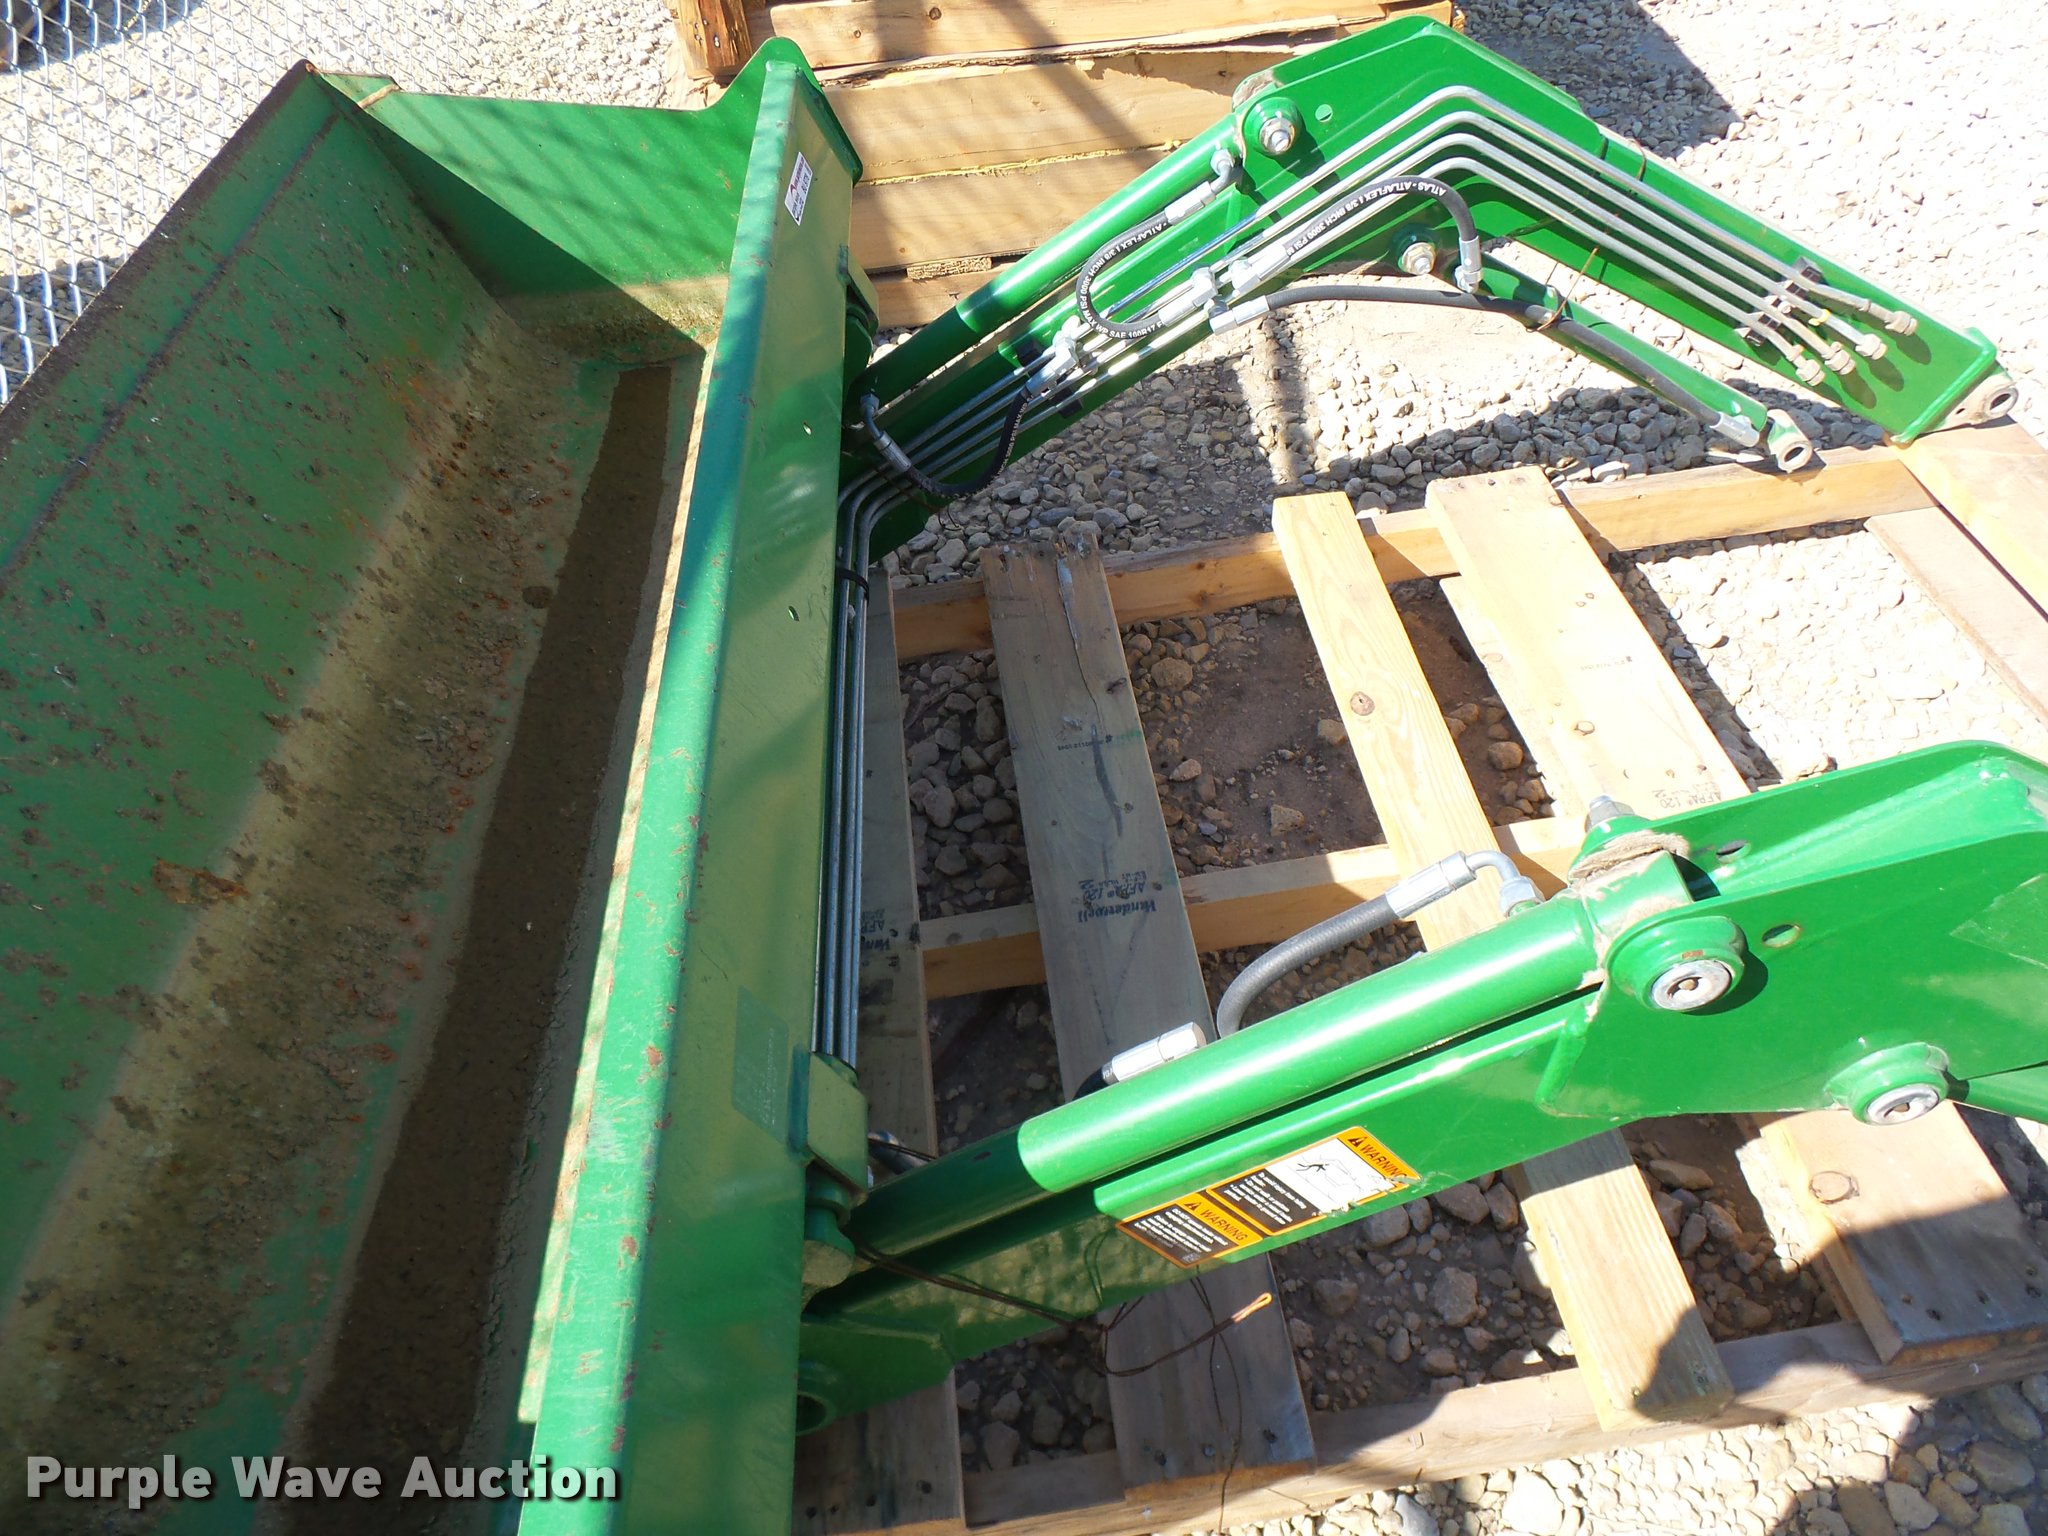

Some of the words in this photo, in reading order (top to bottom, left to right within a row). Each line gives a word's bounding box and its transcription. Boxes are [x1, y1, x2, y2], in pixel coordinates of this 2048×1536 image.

[1365, 181, 1412, 202] ATLAFLEX
[1418, 181, 1447, 197] ATLAS
[1324, 208, 1346, 227] INCH
[1121, 222, 1163, 250] ATLAFLEX
[1308, 223, 1326, 241] 3000
[1294, 236, 1309, 250] PSI
[1088, 258, 1106, 277] INCH
[1080, 276, 1092, 294] 3000
[1079, 295, 1088, 311] PSI
[1082, 309, 1097, 327] MAX
[1095, 324, 1109, 335] WP
[1109, 329, 1127, 339] SAE
[1201, 1209, 1248, 1241] WARNING
